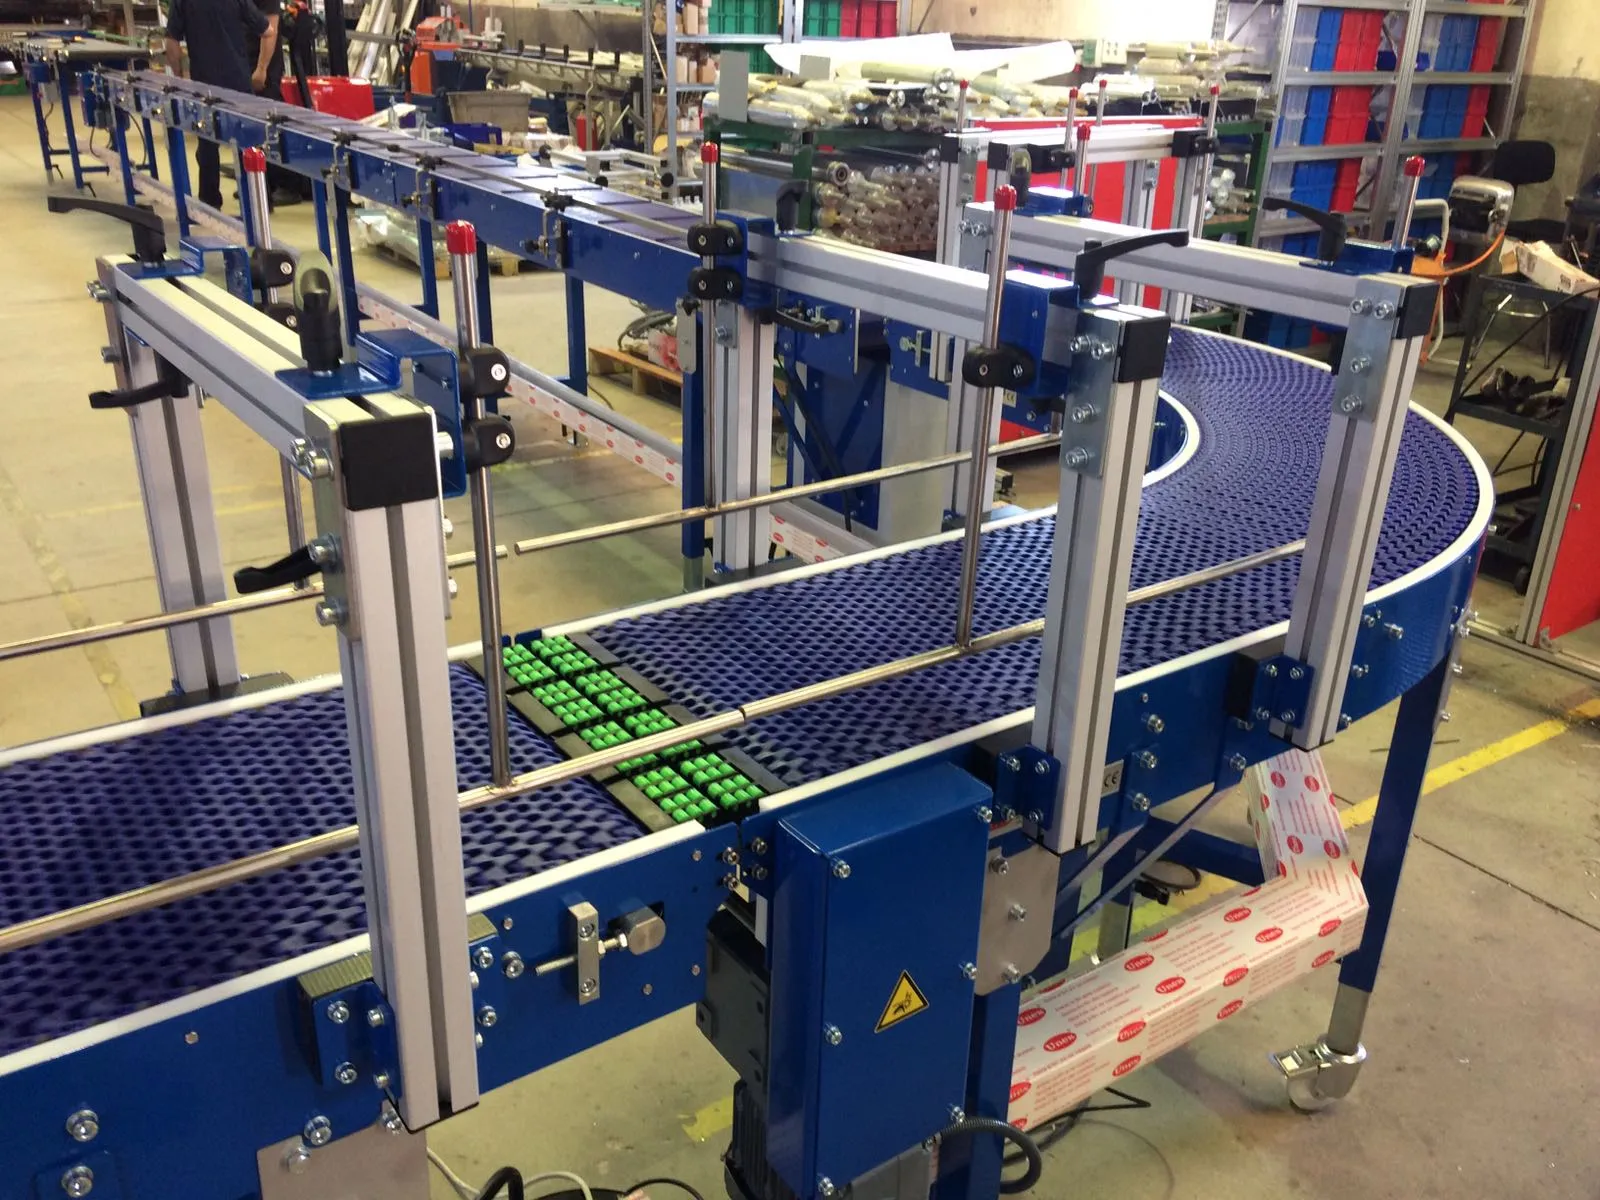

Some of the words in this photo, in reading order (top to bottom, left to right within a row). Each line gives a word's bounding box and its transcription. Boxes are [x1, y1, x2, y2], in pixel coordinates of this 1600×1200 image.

[1104, 770, 1120, 788] CE
[1125, 955, 1154, 970] Unex
[1157, 977, 1185, 992] Unex
[1045, 1033, 1076, 1051] Unex
